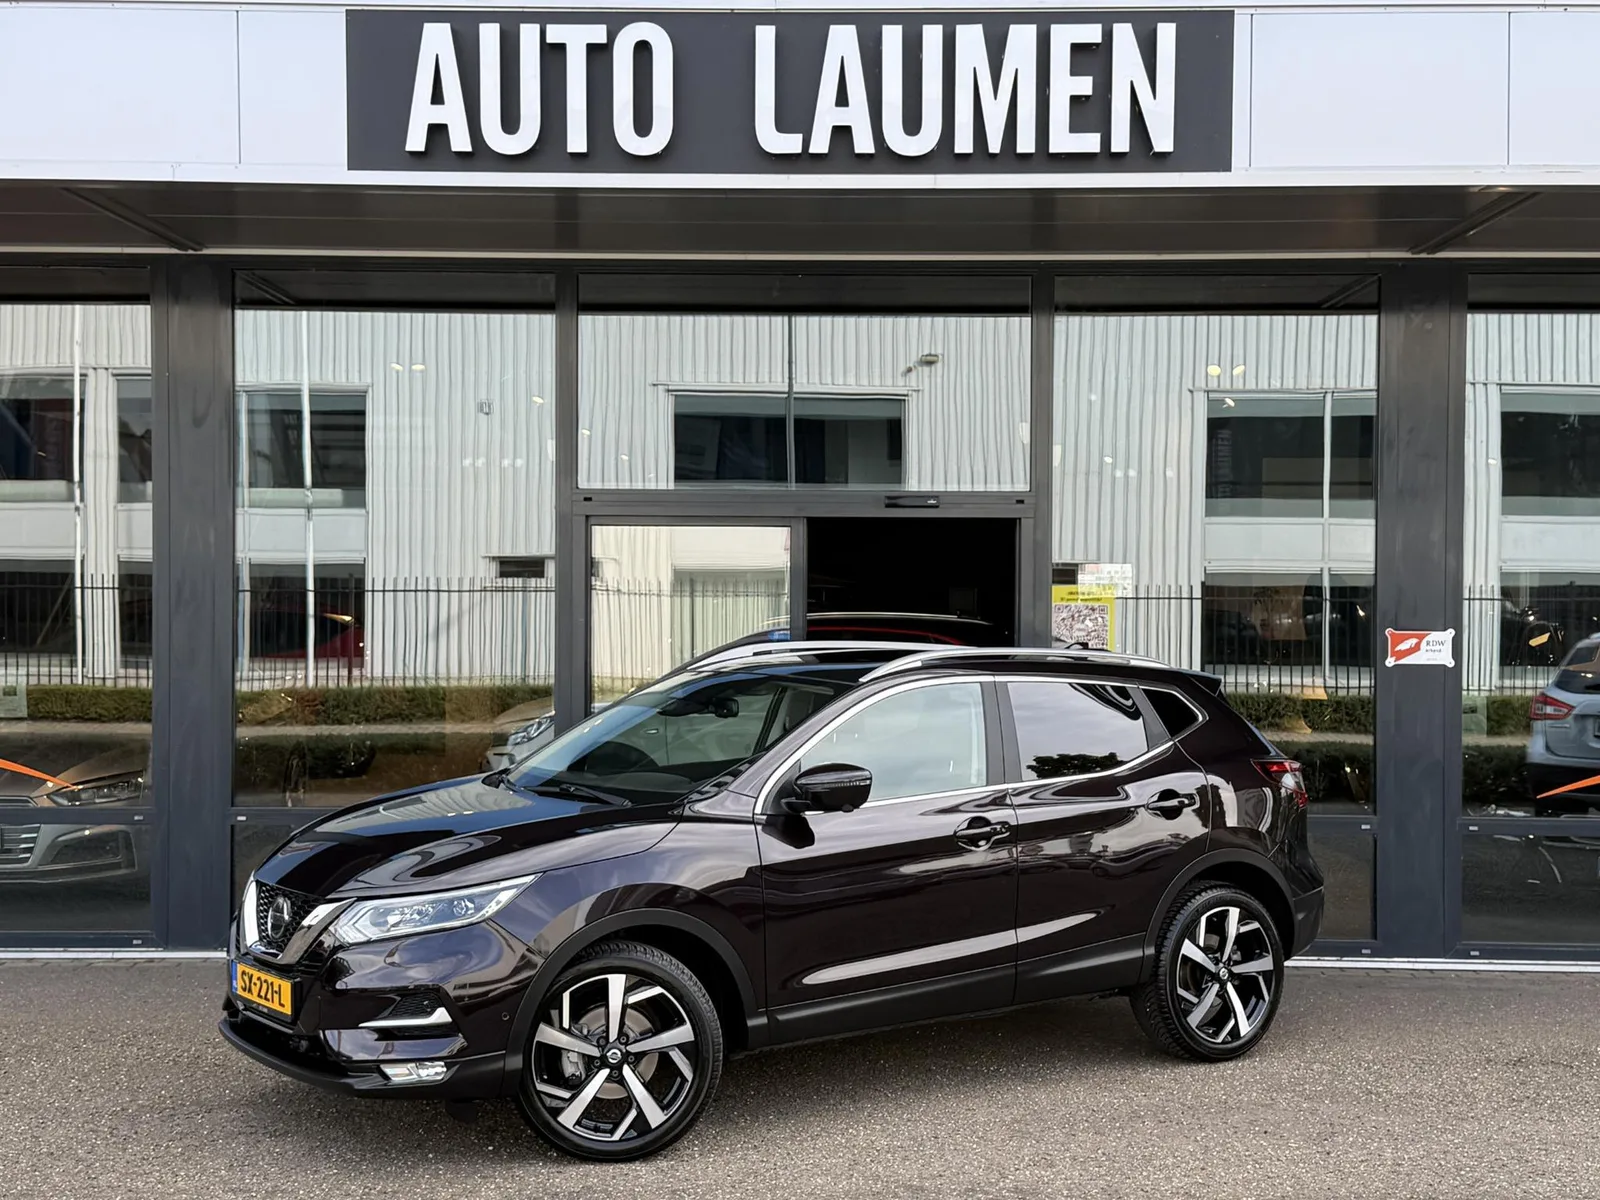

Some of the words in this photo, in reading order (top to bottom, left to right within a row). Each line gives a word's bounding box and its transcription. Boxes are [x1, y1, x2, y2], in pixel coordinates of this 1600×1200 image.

[404, 21, 675, 156] AUTO
[754, 22, 1178, 157] LAUMEN
[1425, 639, 1447, 647] RDW
[240, 970, 286, 1008] SX-221-L
